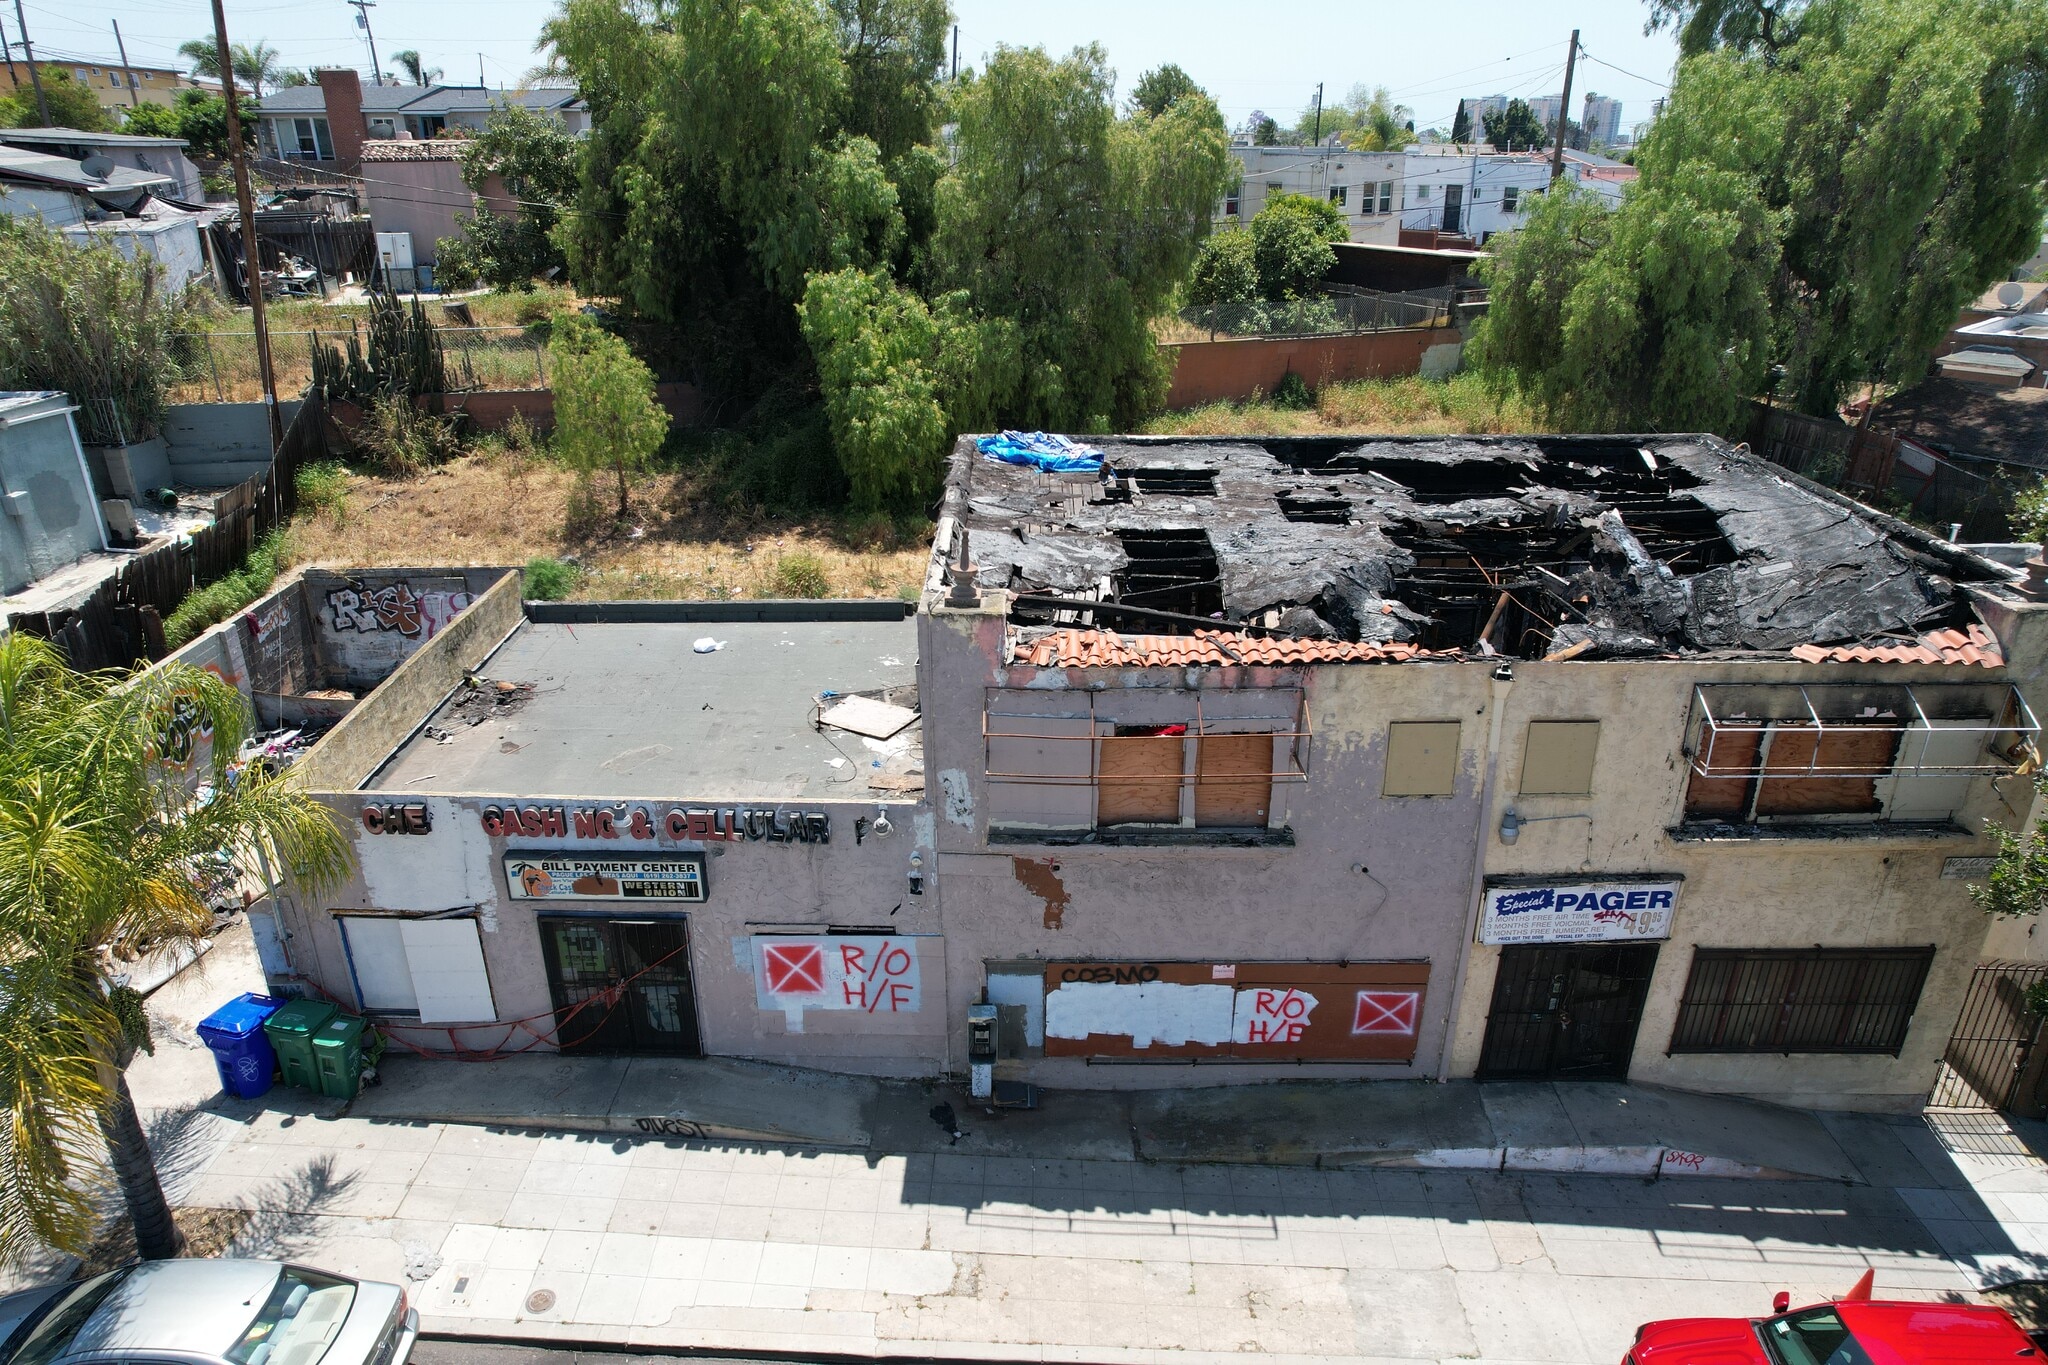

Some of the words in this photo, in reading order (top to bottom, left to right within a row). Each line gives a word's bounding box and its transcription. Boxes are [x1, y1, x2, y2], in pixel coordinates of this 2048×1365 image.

[666, 808, 829, 845] CELLULAR
[541, 862, 571, 872] BILL
[574, 862, 637, 873] PAYMENT
[641, 863, 696, 873] CENTER
[624, 881, 686, 890] WESTERN
[1502, 894, 1545, 912] Special
[1555, 891, 1673, 912] PAGER
[1494, 914, 1530, 923] MONTHS
[1572, 912, 1590, 920] TIME
[1493, 929, 1528, 937] MONTHS
[1530, 927, 1550, 935] FREE
[1552, 926, 1589, 935] NUMERIC
[840, 941, 911, 982] R/O
[1062, 965, 1160, 985] COSMO
[843, 978, 914, 1014] H/F
[1256, 987, 1305, 1018] R/O
